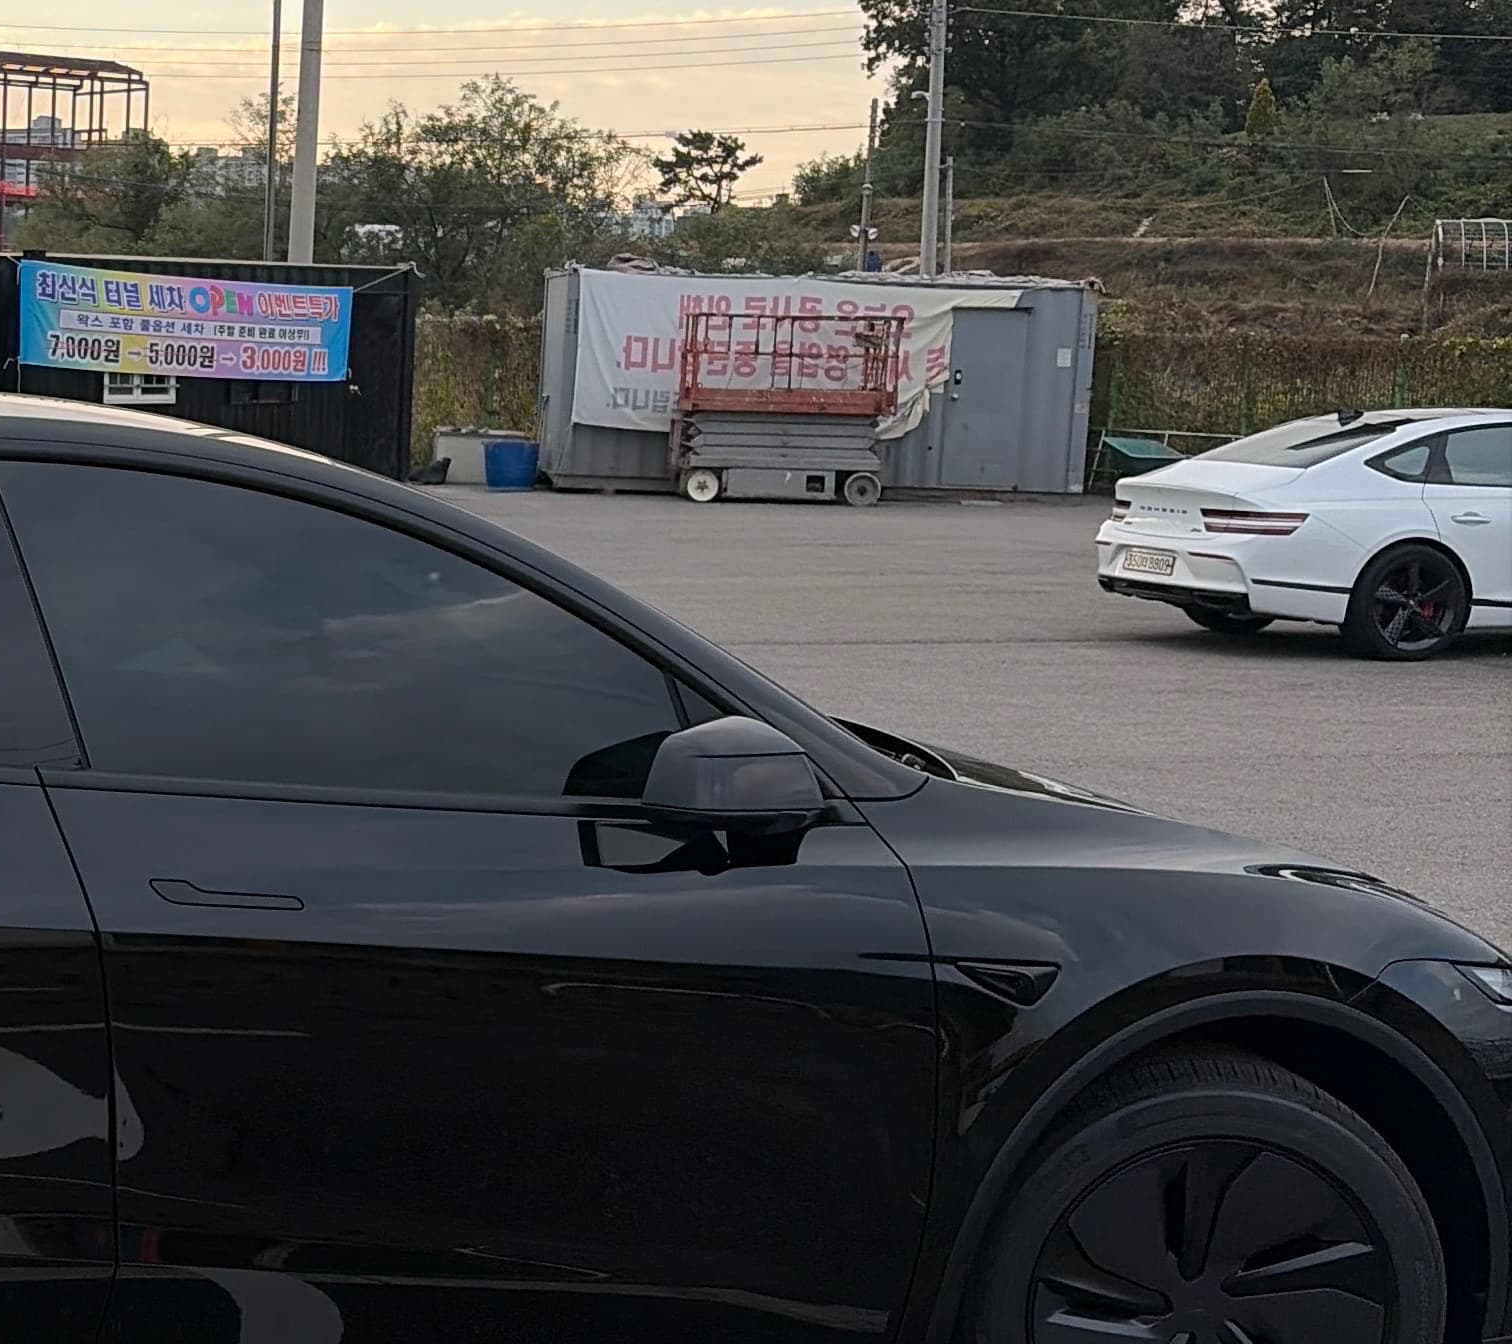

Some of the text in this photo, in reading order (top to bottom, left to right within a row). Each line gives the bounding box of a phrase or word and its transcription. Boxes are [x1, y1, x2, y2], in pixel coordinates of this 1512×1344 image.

[37, 270, 339, 321] 최신식 터널 세차 OPEN 이벤트특가
[76, 314, 103, 328] 왁스
[109, 316, 134, 331] 포함
[180, 322, 204, 335] 세차
[49, 333, 121, 363] 7,000원
[149, 342, 215, 368] 5,000원
[242, 345, 307, 372] 3,000원
